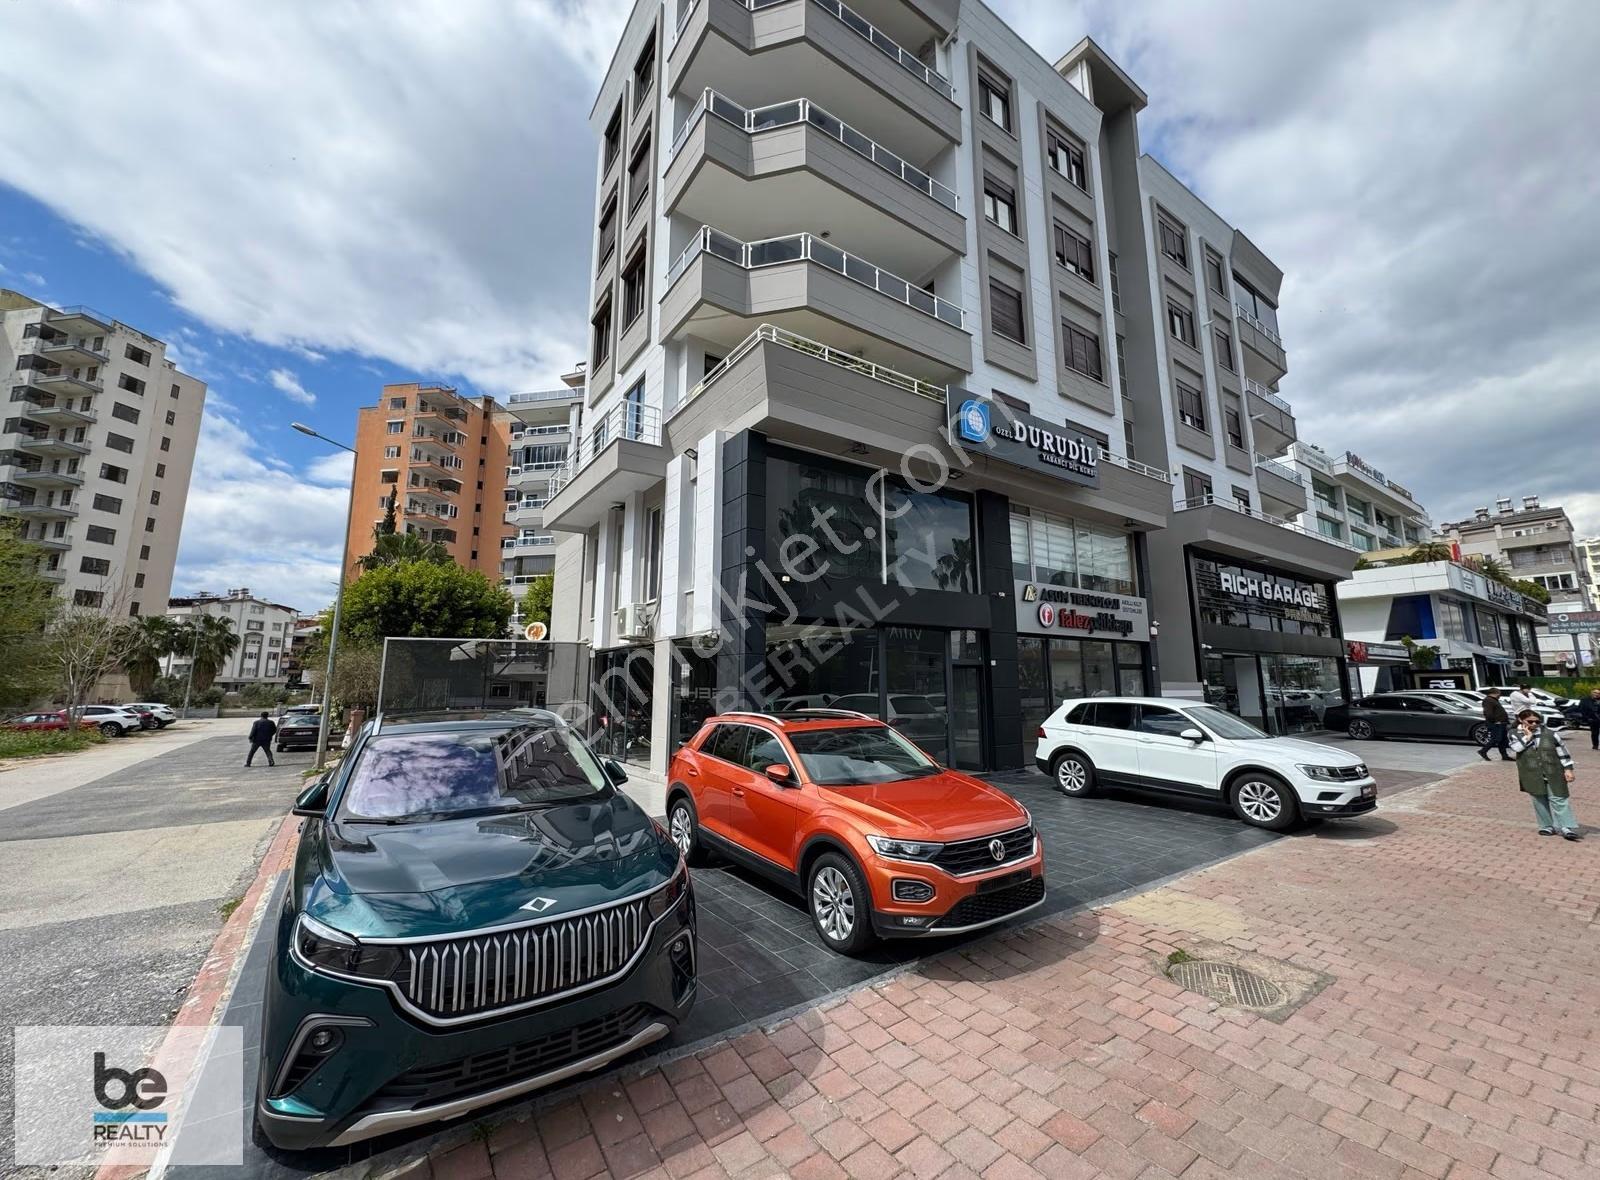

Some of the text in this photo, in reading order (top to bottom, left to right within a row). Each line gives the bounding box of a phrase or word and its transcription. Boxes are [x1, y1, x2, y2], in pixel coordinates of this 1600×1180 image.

[1013, 419, 1097, 467] DURUDİL
[1220, 571, 1320, 609] RICH GARAGE
